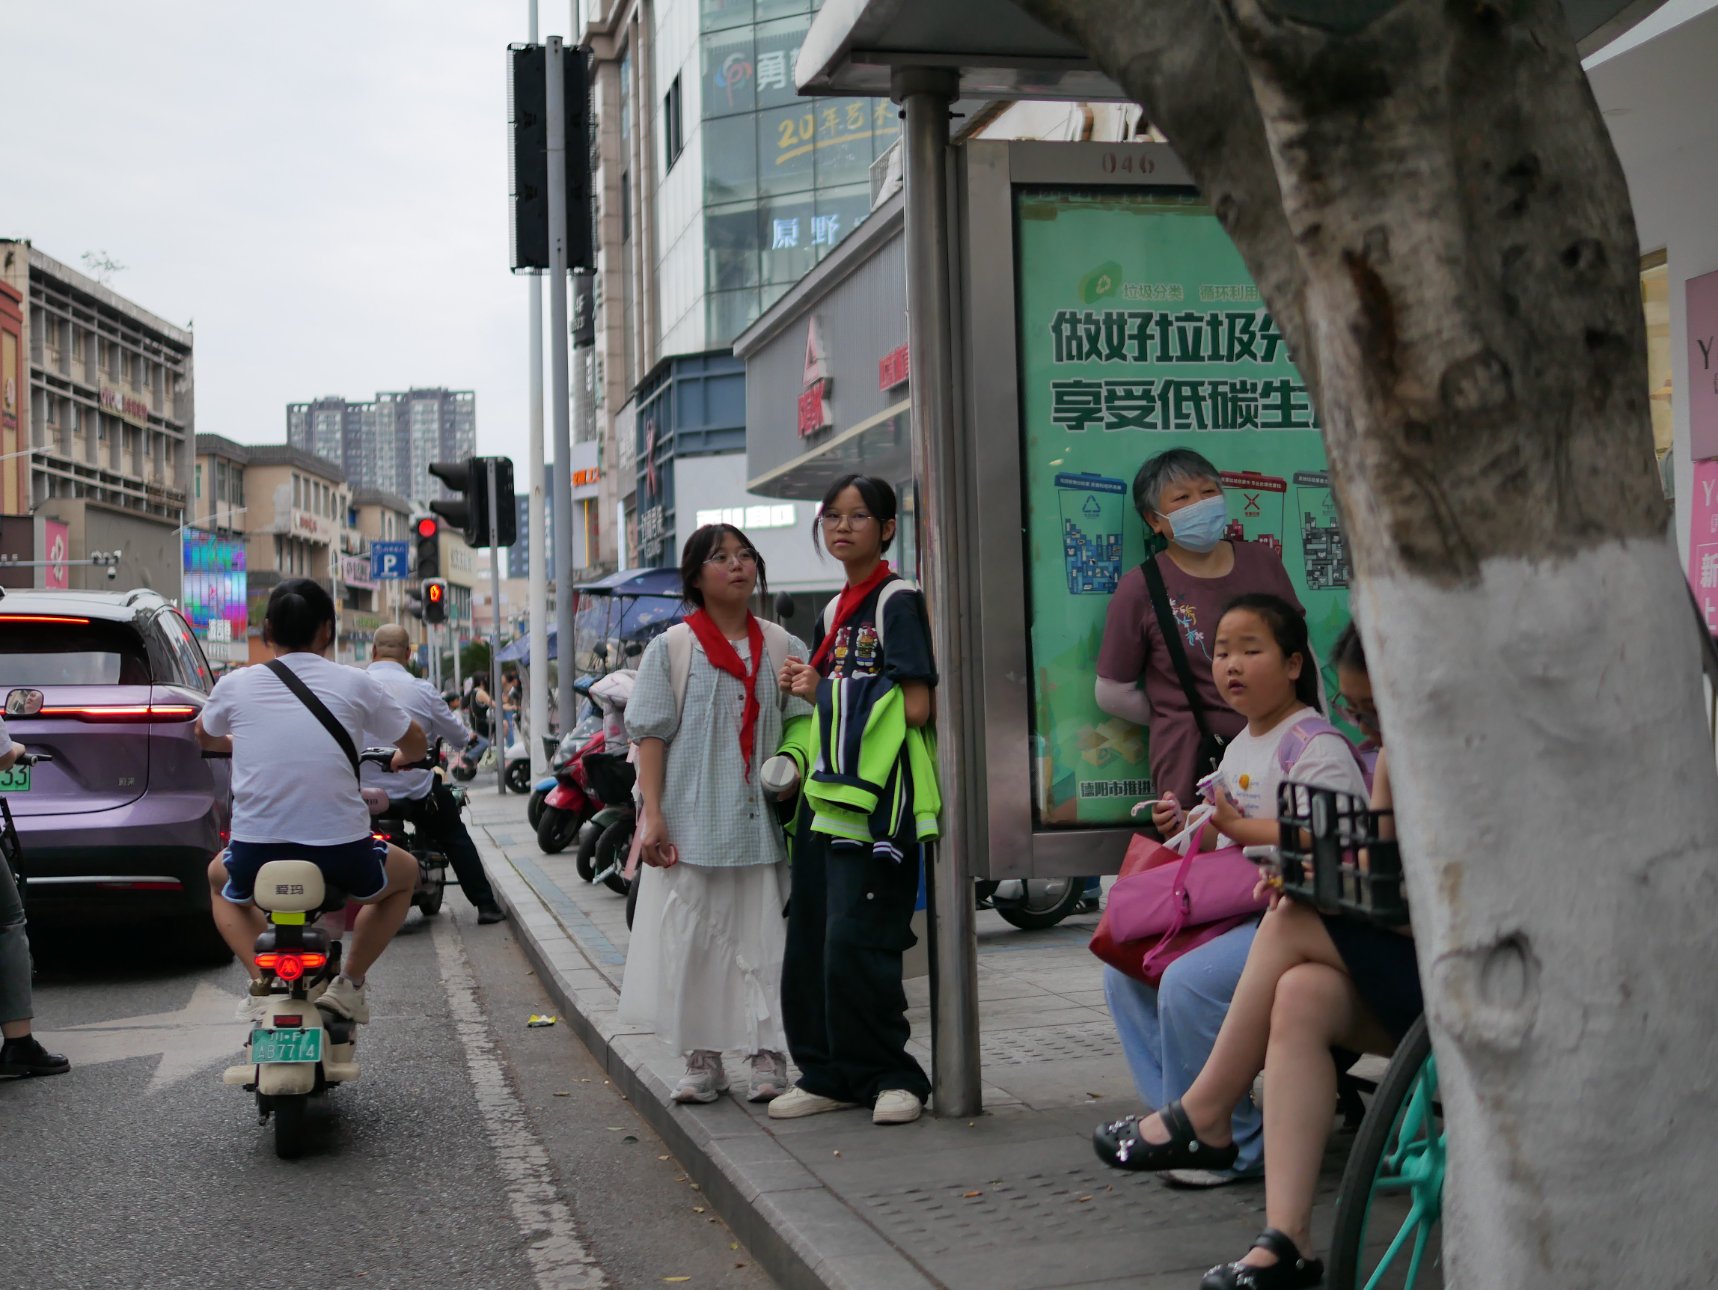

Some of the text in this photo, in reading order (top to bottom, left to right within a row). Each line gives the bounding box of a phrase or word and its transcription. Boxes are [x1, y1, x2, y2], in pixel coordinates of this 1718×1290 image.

[1102, 151, 1155, 174] 046
[772, 213, 870, 250] 原野
[1123, 284, 1261, 301] 垃圾分类 循环利用
[1050, 378, 1322, 432] 享受低碳生
[1079, 779, 1156, 799] 德阳市推进
[275, 884, 305, 896] 爱玛
[257, 1042, 316, 1059] AB7714
